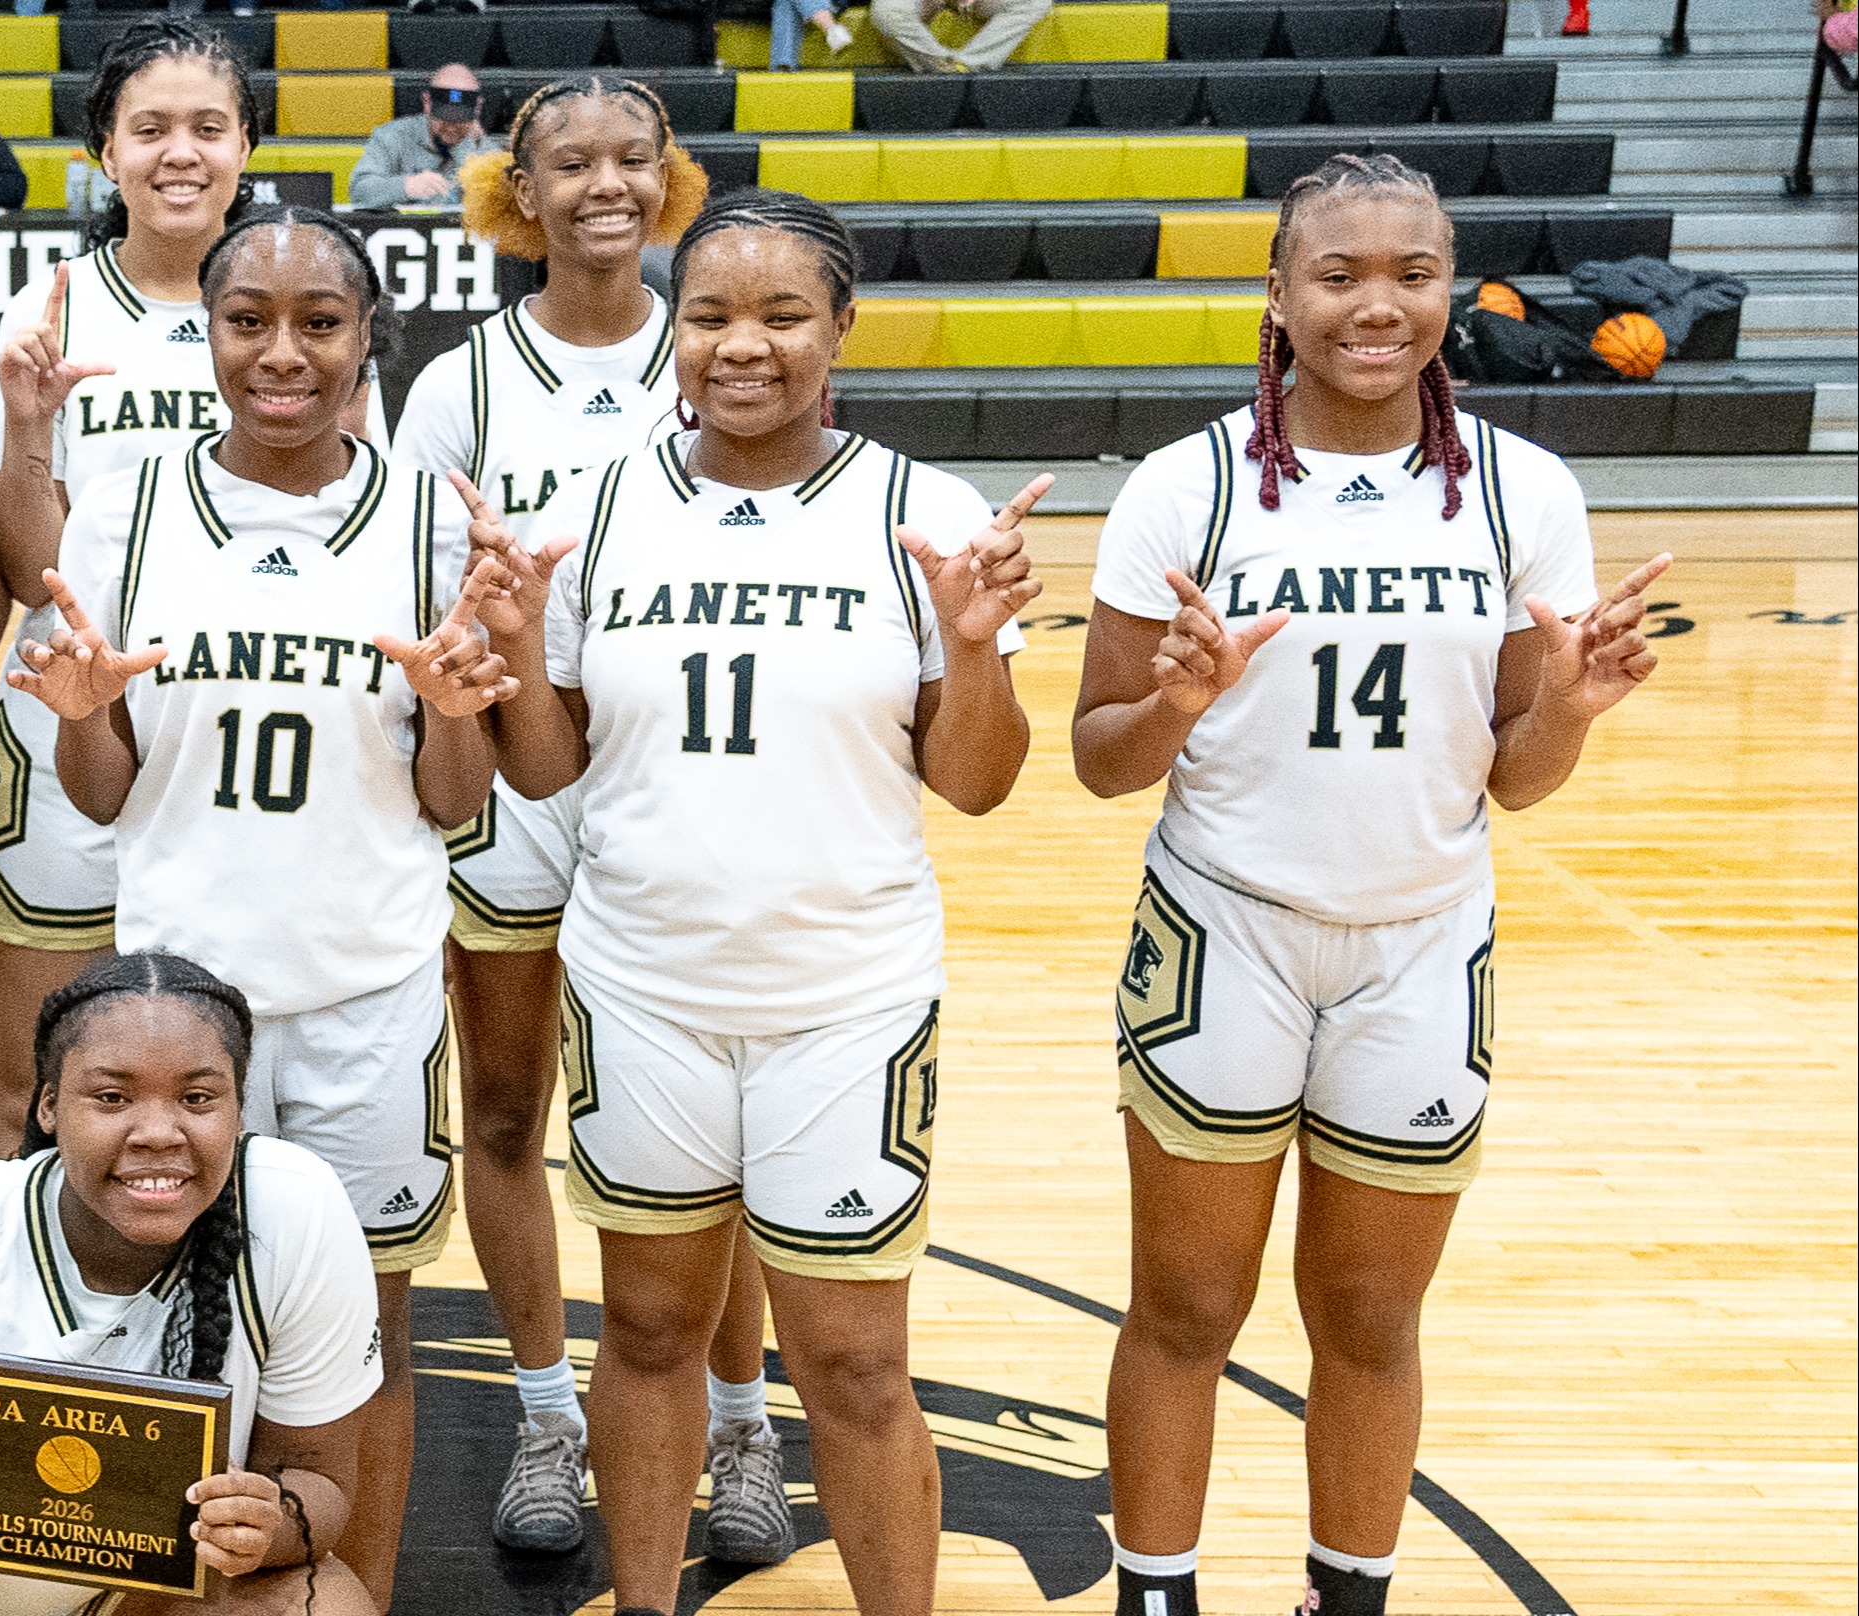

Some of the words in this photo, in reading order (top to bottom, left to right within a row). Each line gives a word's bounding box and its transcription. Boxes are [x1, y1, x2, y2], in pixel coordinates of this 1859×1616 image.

[166, 333, 206, 343] adidas
[582, 404, 622, 415] adidas
[1335, 491, 1385, 503] adidas
[719, 515, 766, 526] adidas
[252, 563, 299, 577] adidas
[1225, 566, 1492, 618] LANETT
[603, 581, 867, 633] LANETT
[681, 652, 757, 757] 11
[1308, 641, 1409, 750] 14
[213, 707, 313, 814] 10
[1409, 1115, 1455, 1128] adidas
[379, 1200, 419, 1215] adidas
[825, 1206, 874, 1218] adidas
[40, 1404, 130, 1438] AREA
[144, 1419, 161, 1442] 6
[39, 1497, 94, 1522] 2026
[28, 1518, 177, 1556] TOURNAMENT
